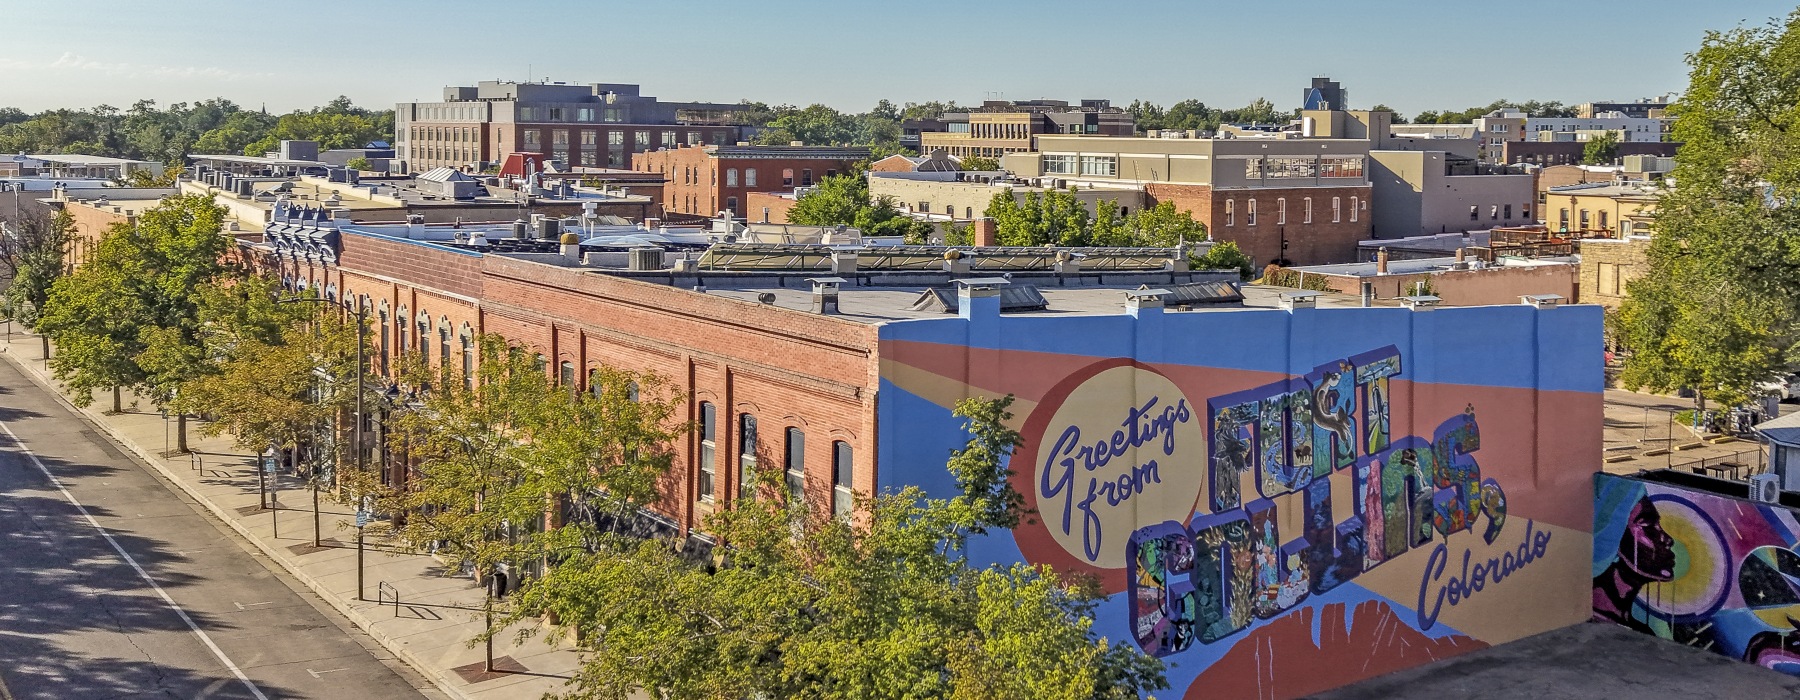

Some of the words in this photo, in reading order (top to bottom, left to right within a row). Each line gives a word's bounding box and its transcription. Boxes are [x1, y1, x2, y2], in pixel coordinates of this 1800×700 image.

[1040, 395, 1190, 536] Greetings
[1207, 344, 1402, 513] FORT
[1076, 459, 1162, 562] from
[1417, 518, 1552, 631] Colorado
